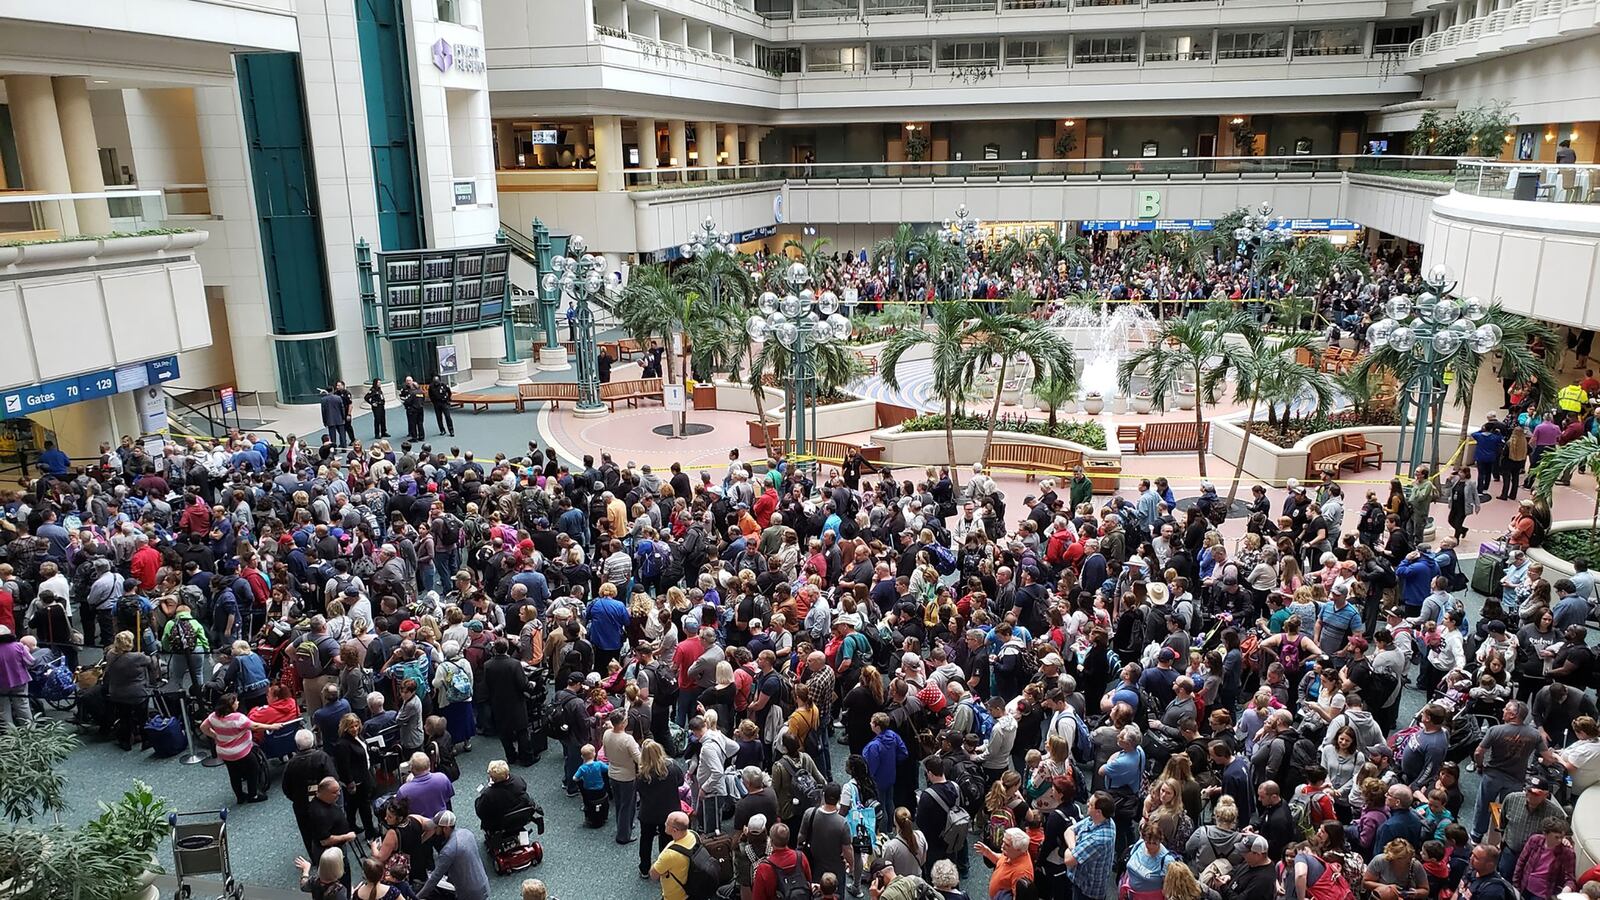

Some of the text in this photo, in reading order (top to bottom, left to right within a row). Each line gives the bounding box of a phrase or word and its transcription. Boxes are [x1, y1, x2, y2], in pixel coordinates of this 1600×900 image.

[1139, 190, 1160, 218] B
[27, 392, 55, 406] Gates
[66, 385, 78, 397] 70
[96, 378, 112, 390] 129
